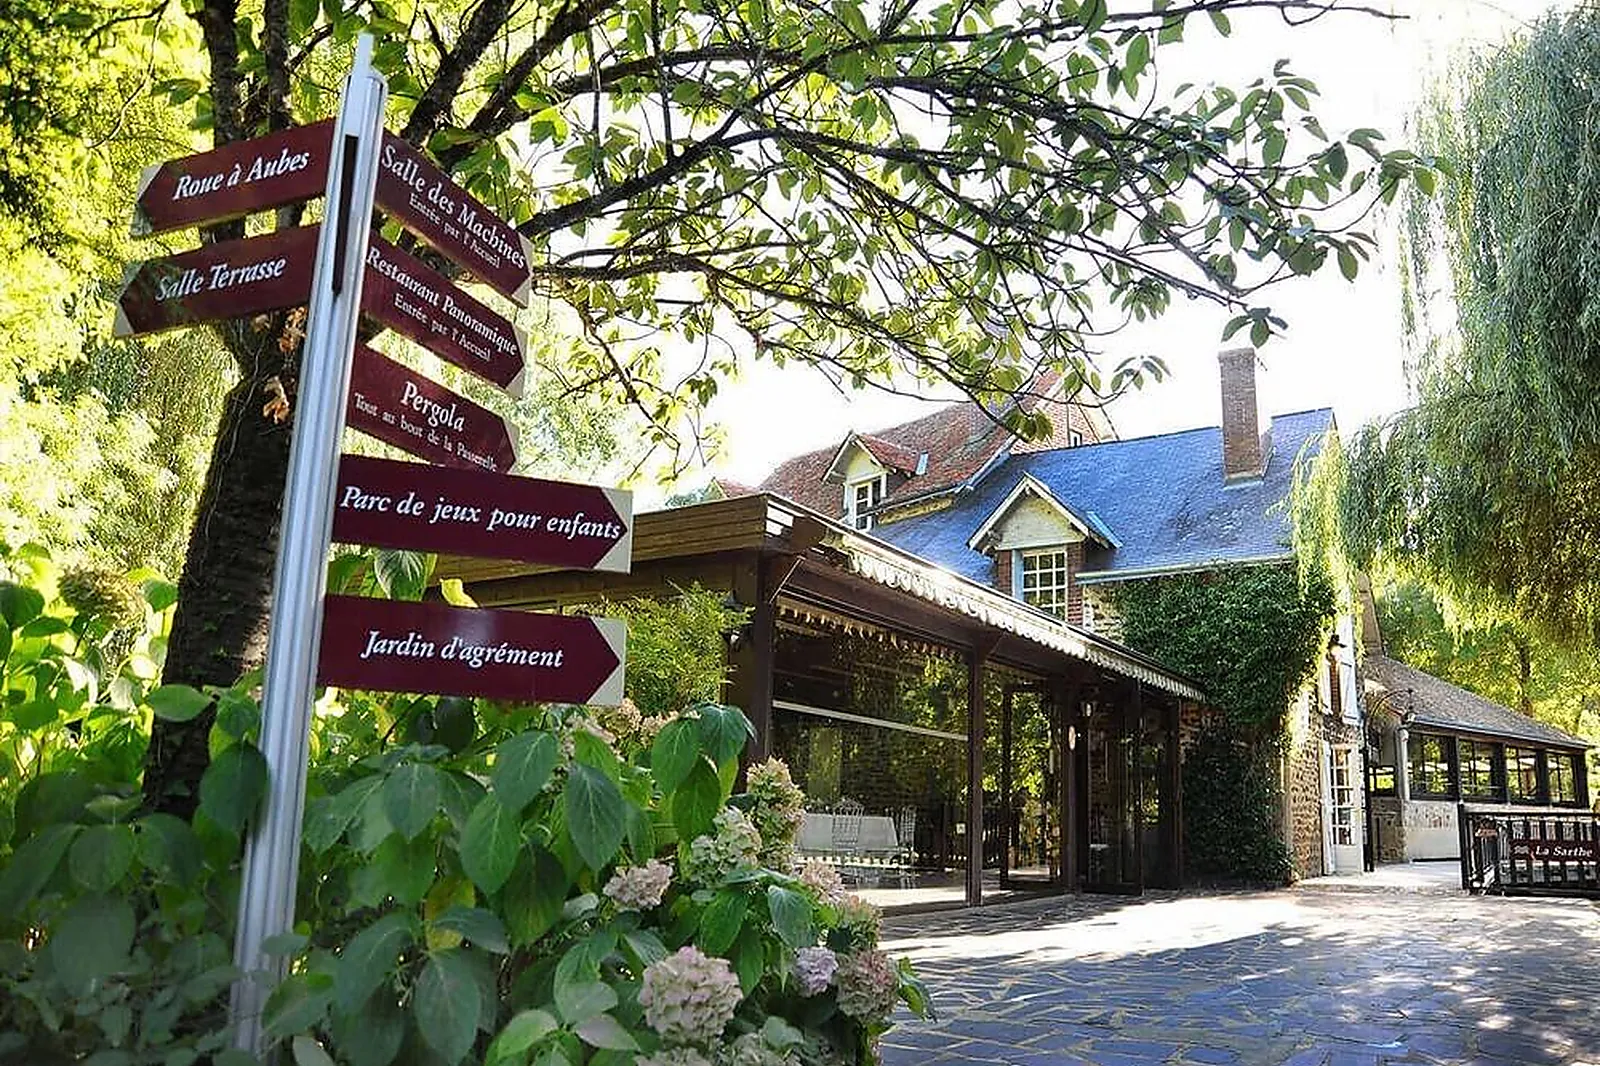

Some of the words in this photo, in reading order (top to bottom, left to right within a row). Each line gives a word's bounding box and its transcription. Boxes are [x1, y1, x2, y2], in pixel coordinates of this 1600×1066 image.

[172, 173, 224, 200] Roue
[227, 163, 242, 187] à
[245, 148, 310, 183] Aubes
[381, 144, 425, 193] Salle
[427, 182, 456, 214] des
[456, 204, 525, 269] Machines
[409, 193, 441, 225] Entrée
[444, 222, 461, 240] par
[155, 268, 204, 301] Salle
[206, 258, 287, 291] Terrasse
[366, 246, 440, 306] Restaurant
[441, 295, 518, 356] Panoramique
[394, 293, 428, 324] Entrée
[431, 320, 450, 335] par
[354, 392, 378, 417] Tout
[382, 411, 396, 425] au
[400, 414, 423, 438] bout
[427, 429, 440, 446] de
[400, 381, 465, 433] Pergola
[339, 486, 391, 513] Parc
[396, 492, 425, 516] de
[429, 497, 481, 524] jeux
[486, 508, 542, 531] pour
[546, 512, 621, 540] enfants
[360, 630, 436, 659] Jardin
[440, 636, 564, 668] d'agrément
[1535, 845, 1550, 856] La
[1553, 845, 1594, 858] Sarthe
